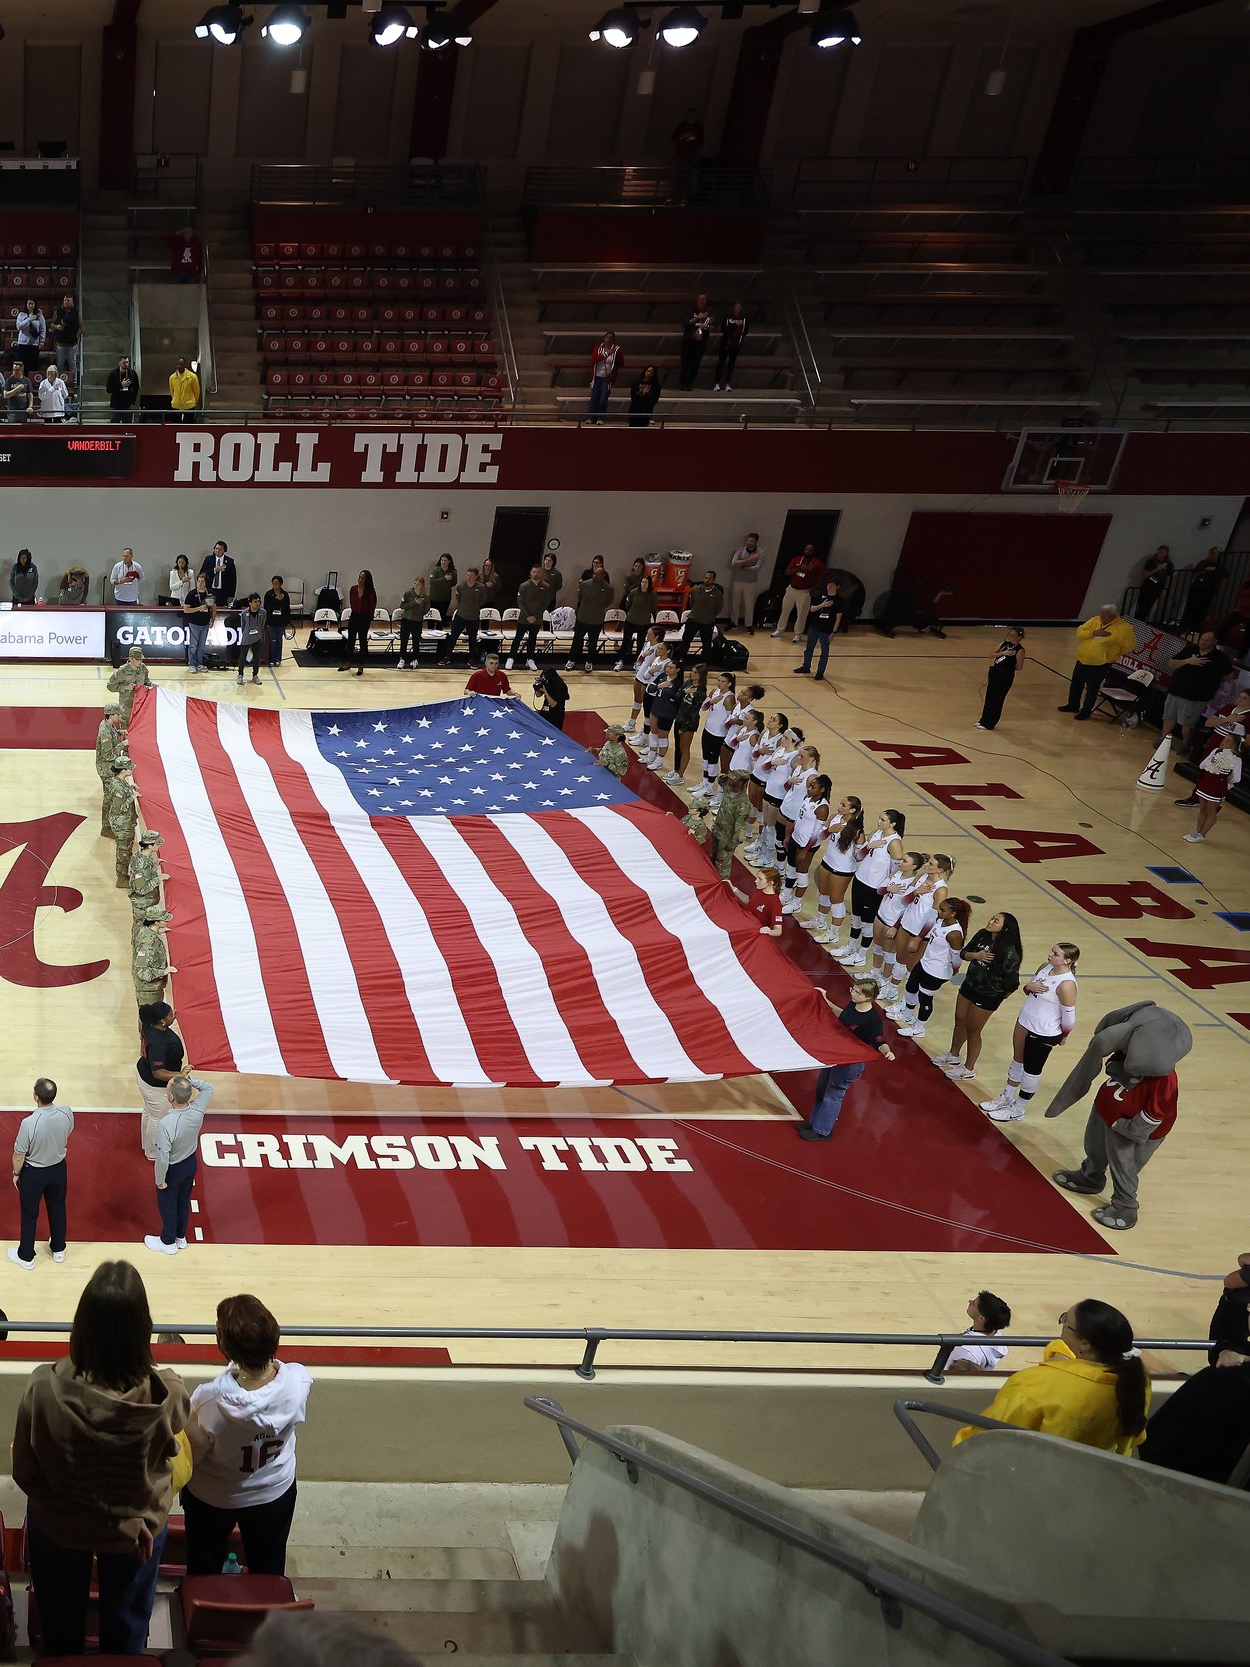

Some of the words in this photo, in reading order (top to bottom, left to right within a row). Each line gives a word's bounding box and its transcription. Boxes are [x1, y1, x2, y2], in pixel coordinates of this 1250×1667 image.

[67, 440, 121, 451] VANDERBILT
[173, 431, 332, 482] ROLL
[353, 432, 504, 484] TIDE
[48, 632, 88, 645] Power
[116, 626, 243, 646] GATOAD
[199, 1133, 508, 1170] CRIMSON
[518, 1136, 695, 1172] TIDE
